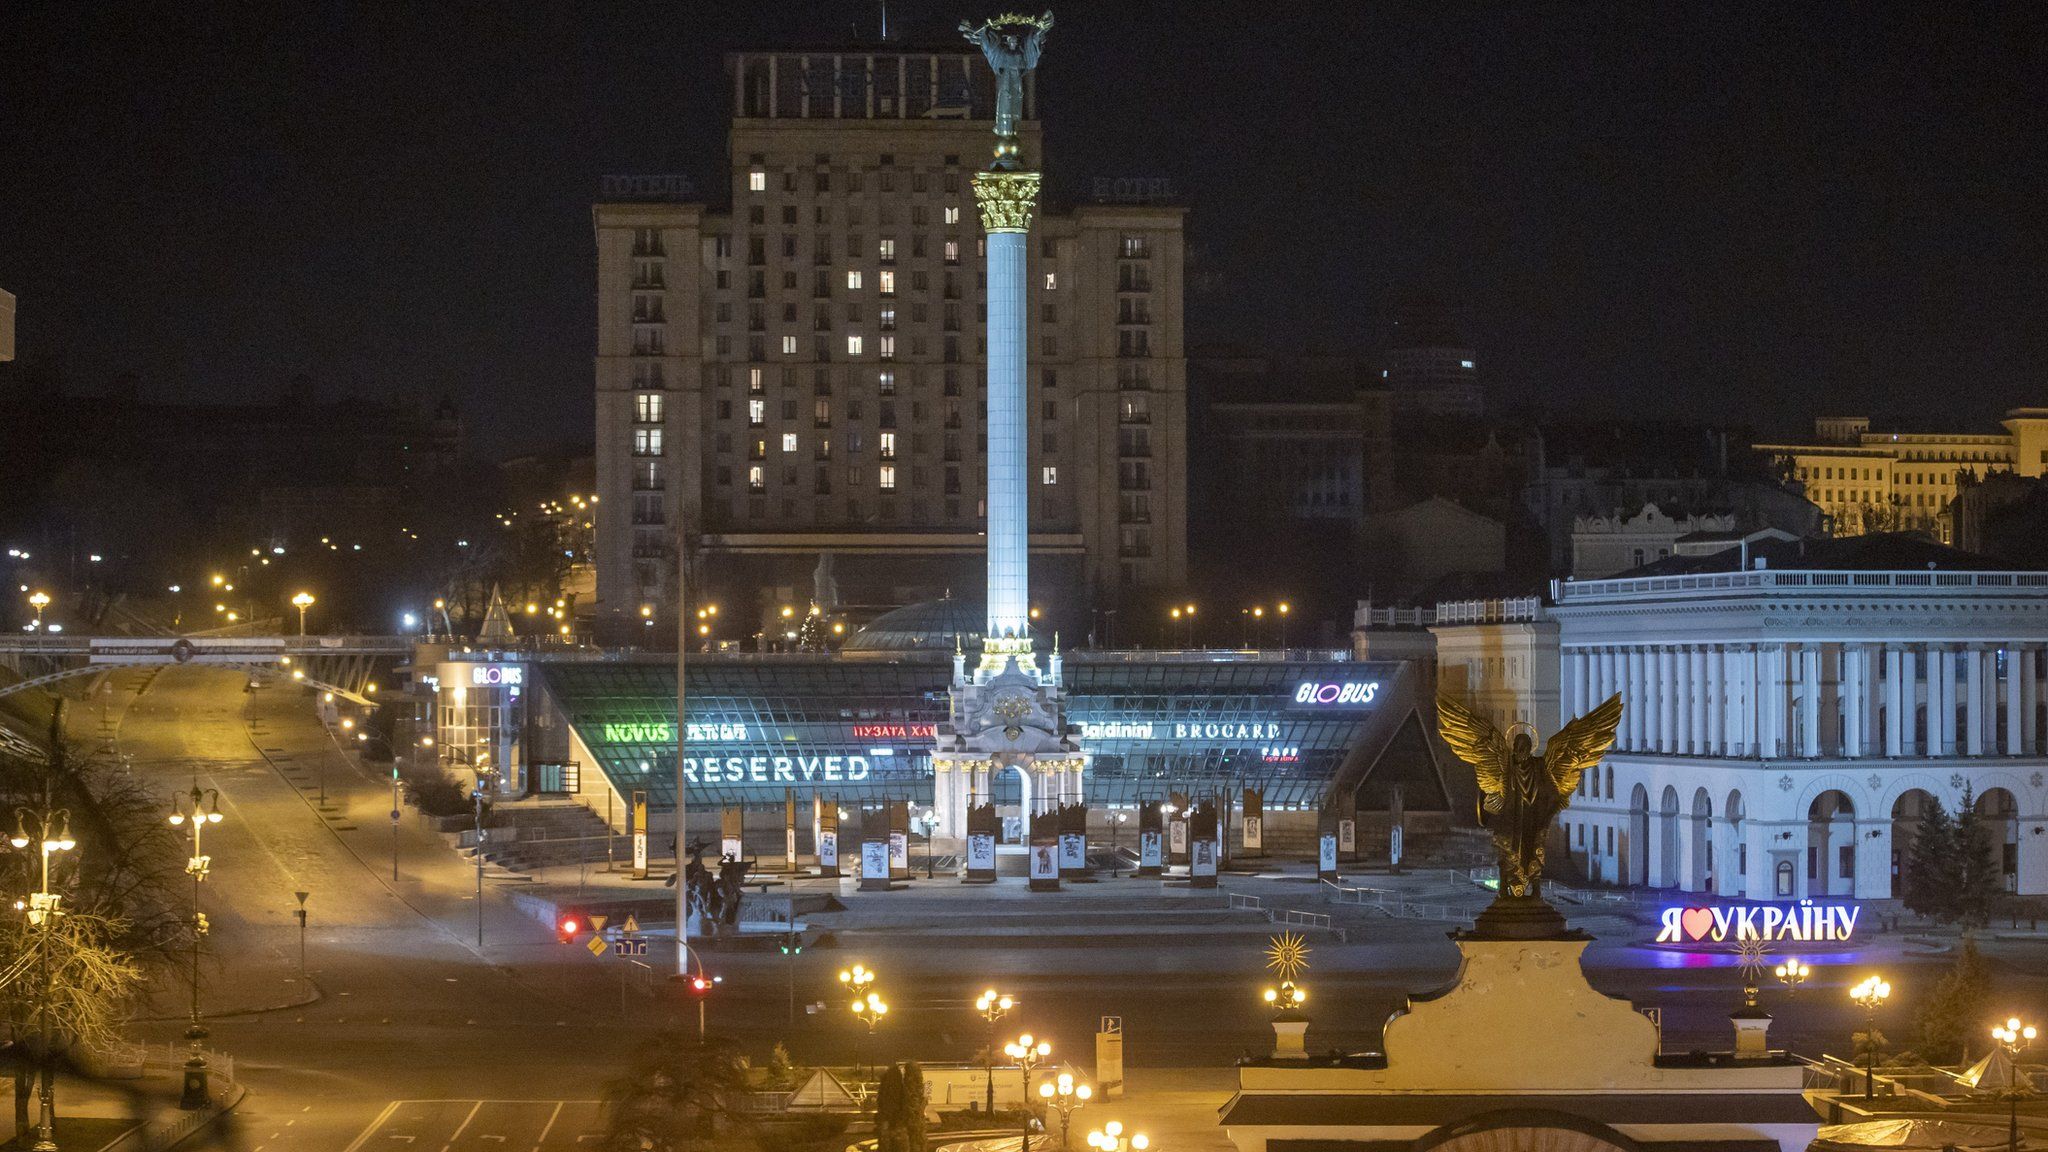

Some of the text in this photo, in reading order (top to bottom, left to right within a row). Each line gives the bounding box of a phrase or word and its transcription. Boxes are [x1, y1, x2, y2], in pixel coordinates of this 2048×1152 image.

[473, 667, 522, 684] GLOBUS
[1295, 682, 1379, 704] GLOBUS
[605, 723, 670, 742] NOVUS
[853, 725, 906, 737] ПУЗАТА
[1175, 723, 1281, 740] BROCARD
[683, 756, 869, 784] RESERVED
[1655, 899, 1861, 942] Я УКРАЇНУ
